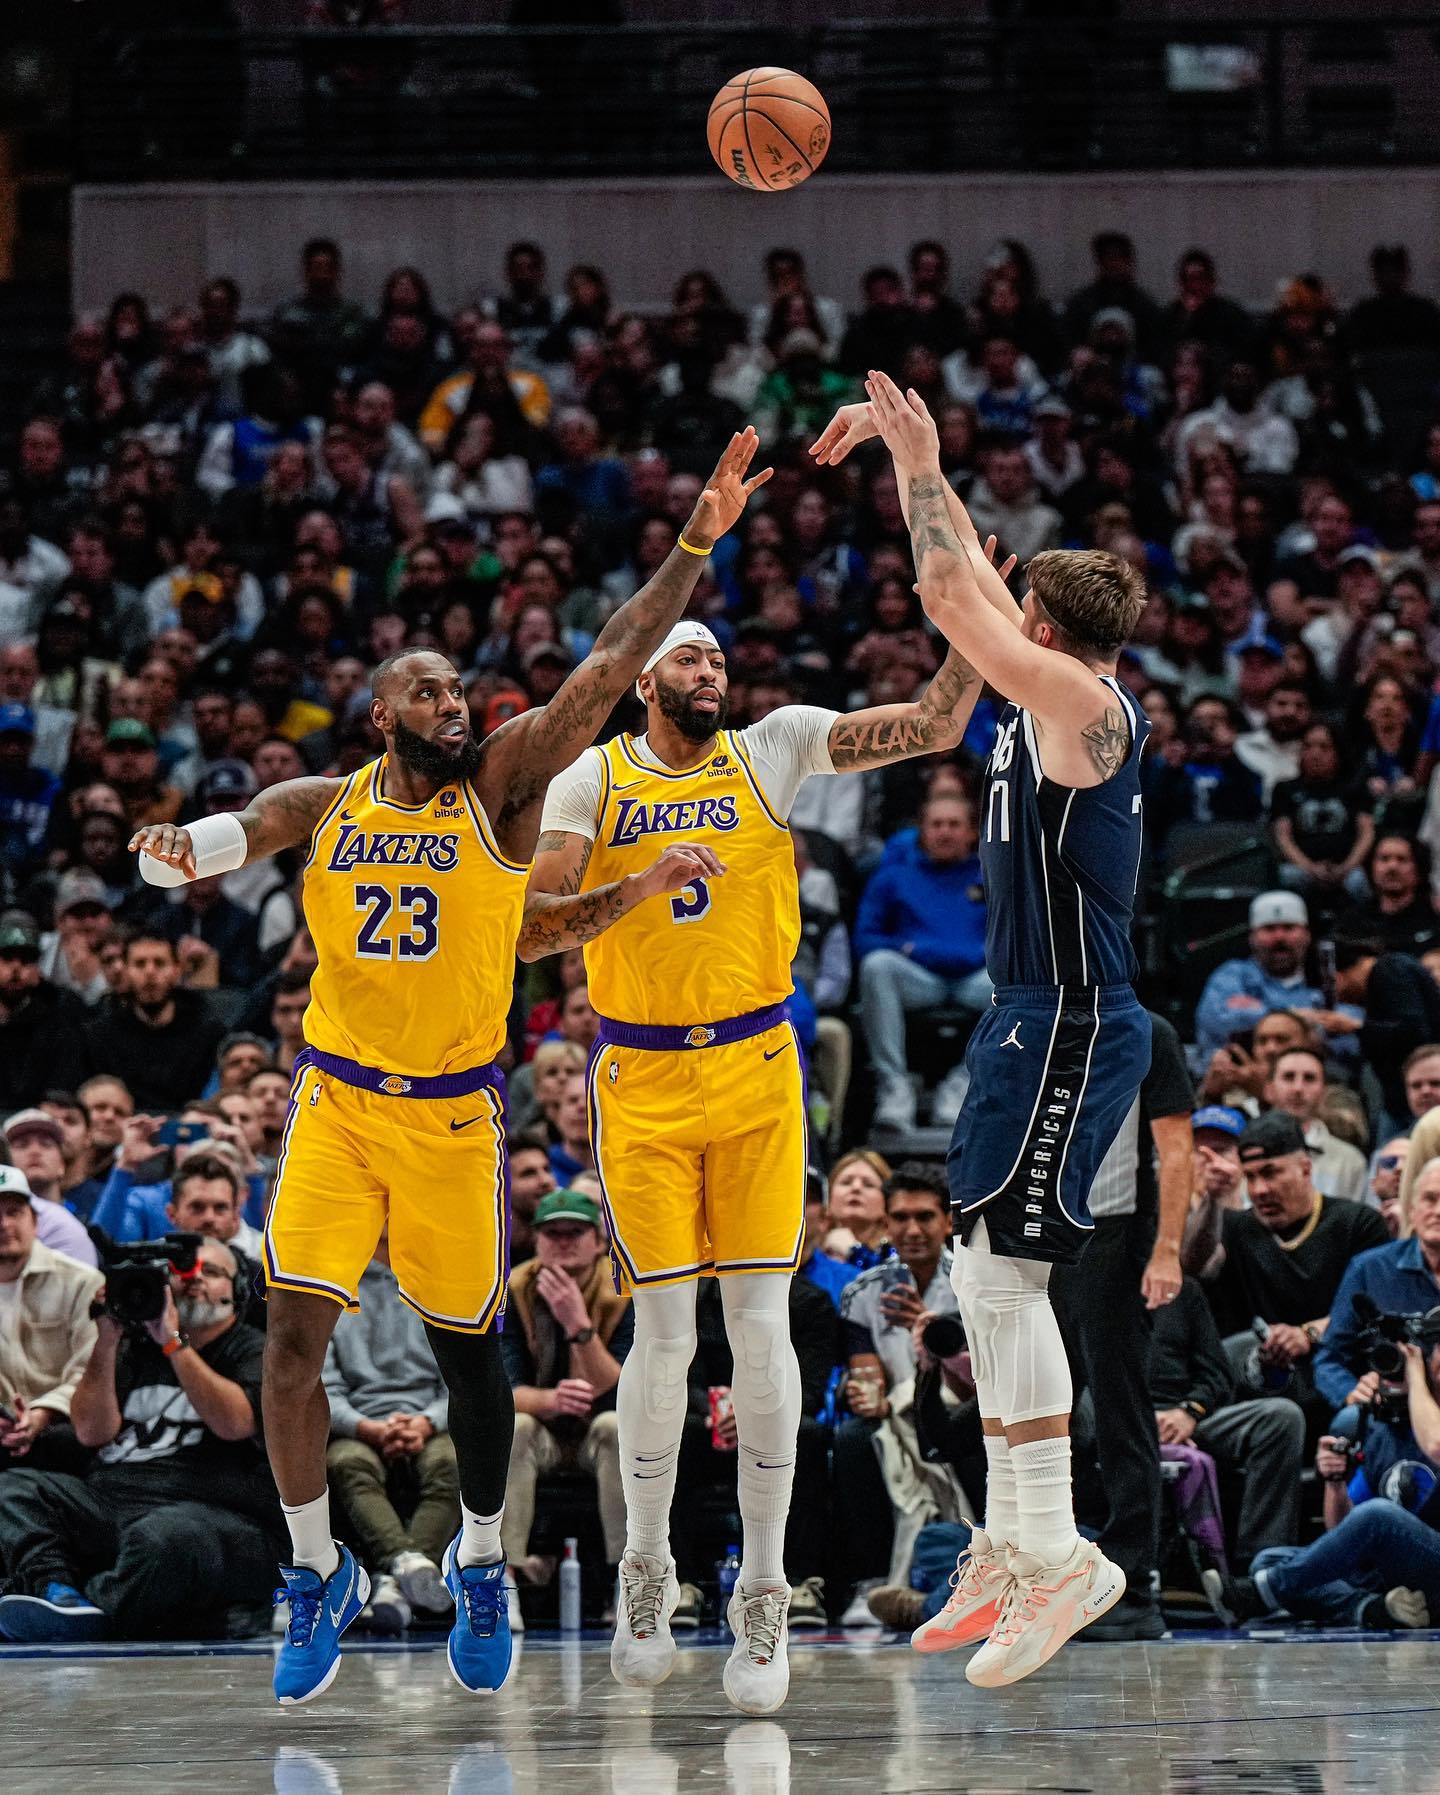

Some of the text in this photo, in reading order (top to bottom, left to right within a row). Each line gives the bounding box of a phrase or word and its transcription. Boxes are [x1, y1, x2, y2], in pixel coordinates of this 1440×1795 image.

[707, 766, 738, 777] bibigo
[434, 806, 465, 818] bibigo
[607, 795, 740, 848] LAKERS
[327, 824, 460, 873] LAKERS
[354, 883, 439, 963] 23
[1024, 1087, 1070, 1238] MAVERICKS
